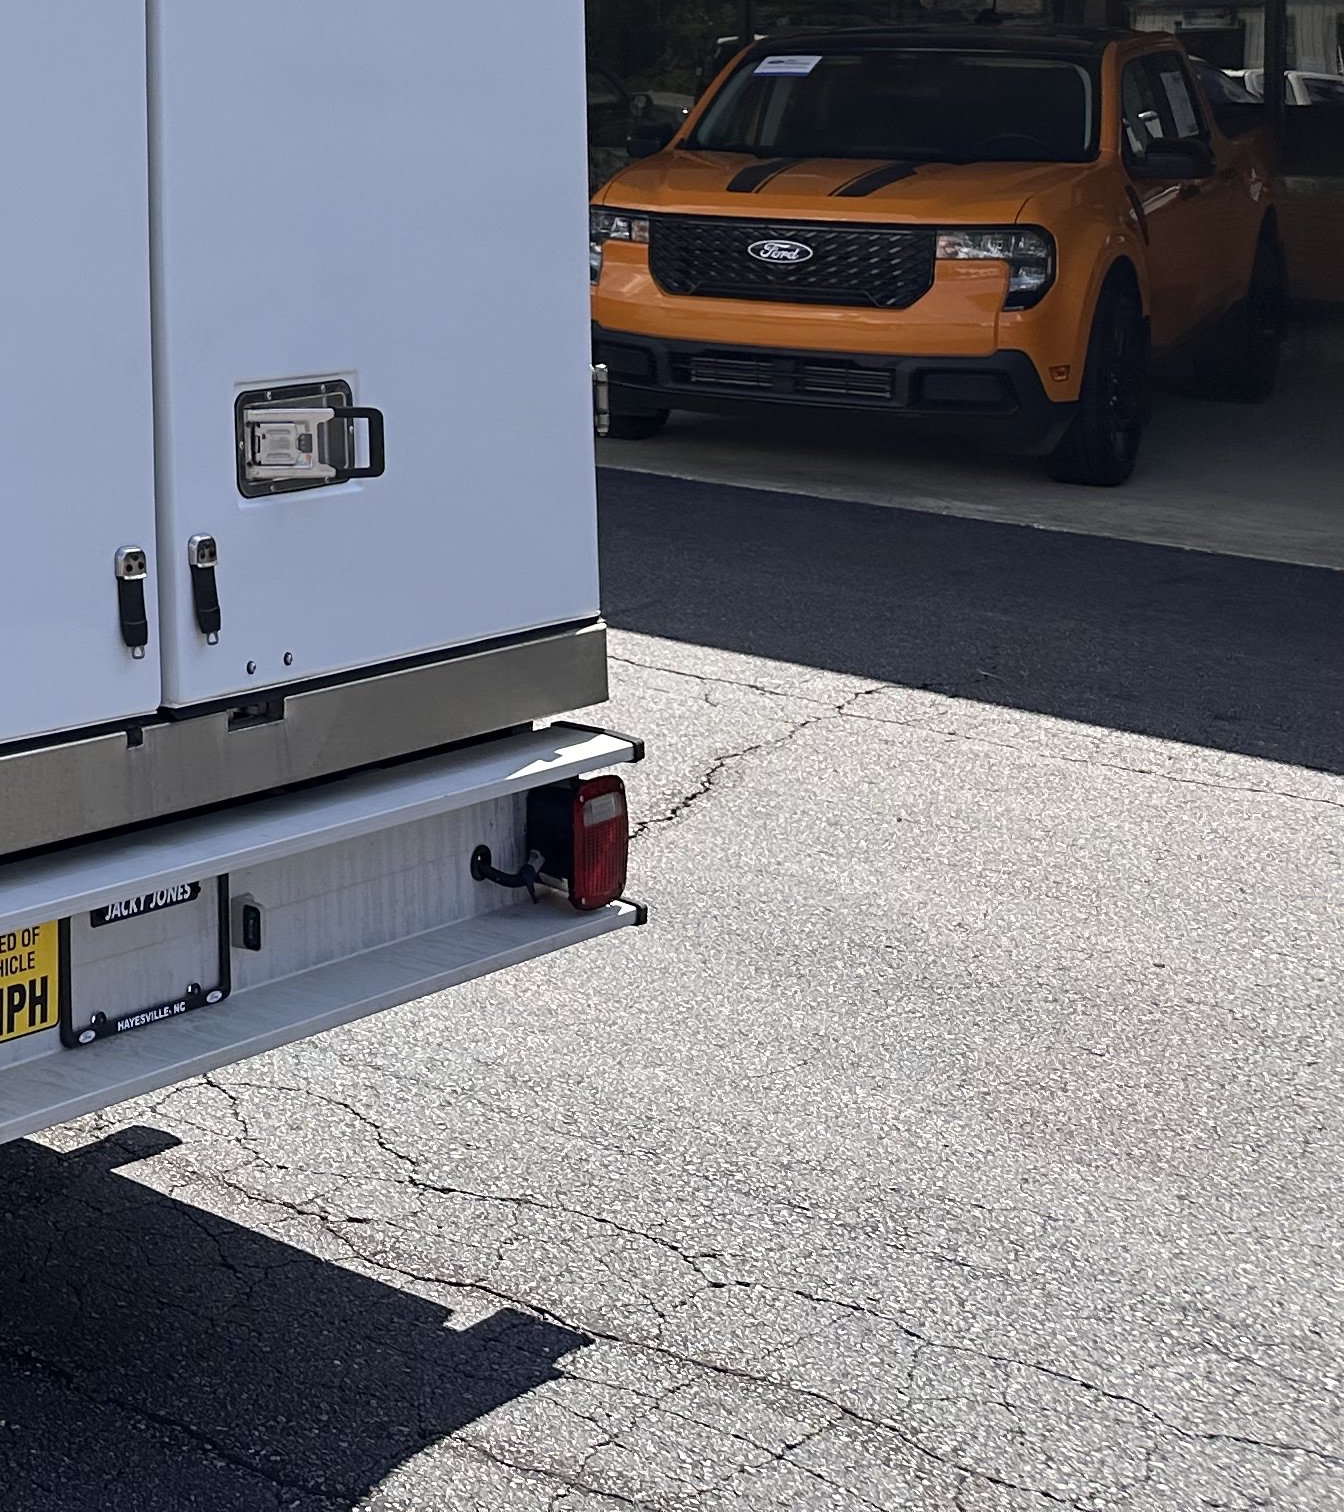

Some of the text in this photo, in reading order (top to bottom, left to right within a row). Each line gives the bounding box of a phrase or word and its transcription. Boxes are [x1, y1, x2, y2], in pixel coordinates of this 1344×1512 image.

[760, 243, 800, 259] Ford
[105, 882, 192, 921] JACKY JONES
[21, 926, 40, 948] OF
[173, 1001, 186, 1014] NC
